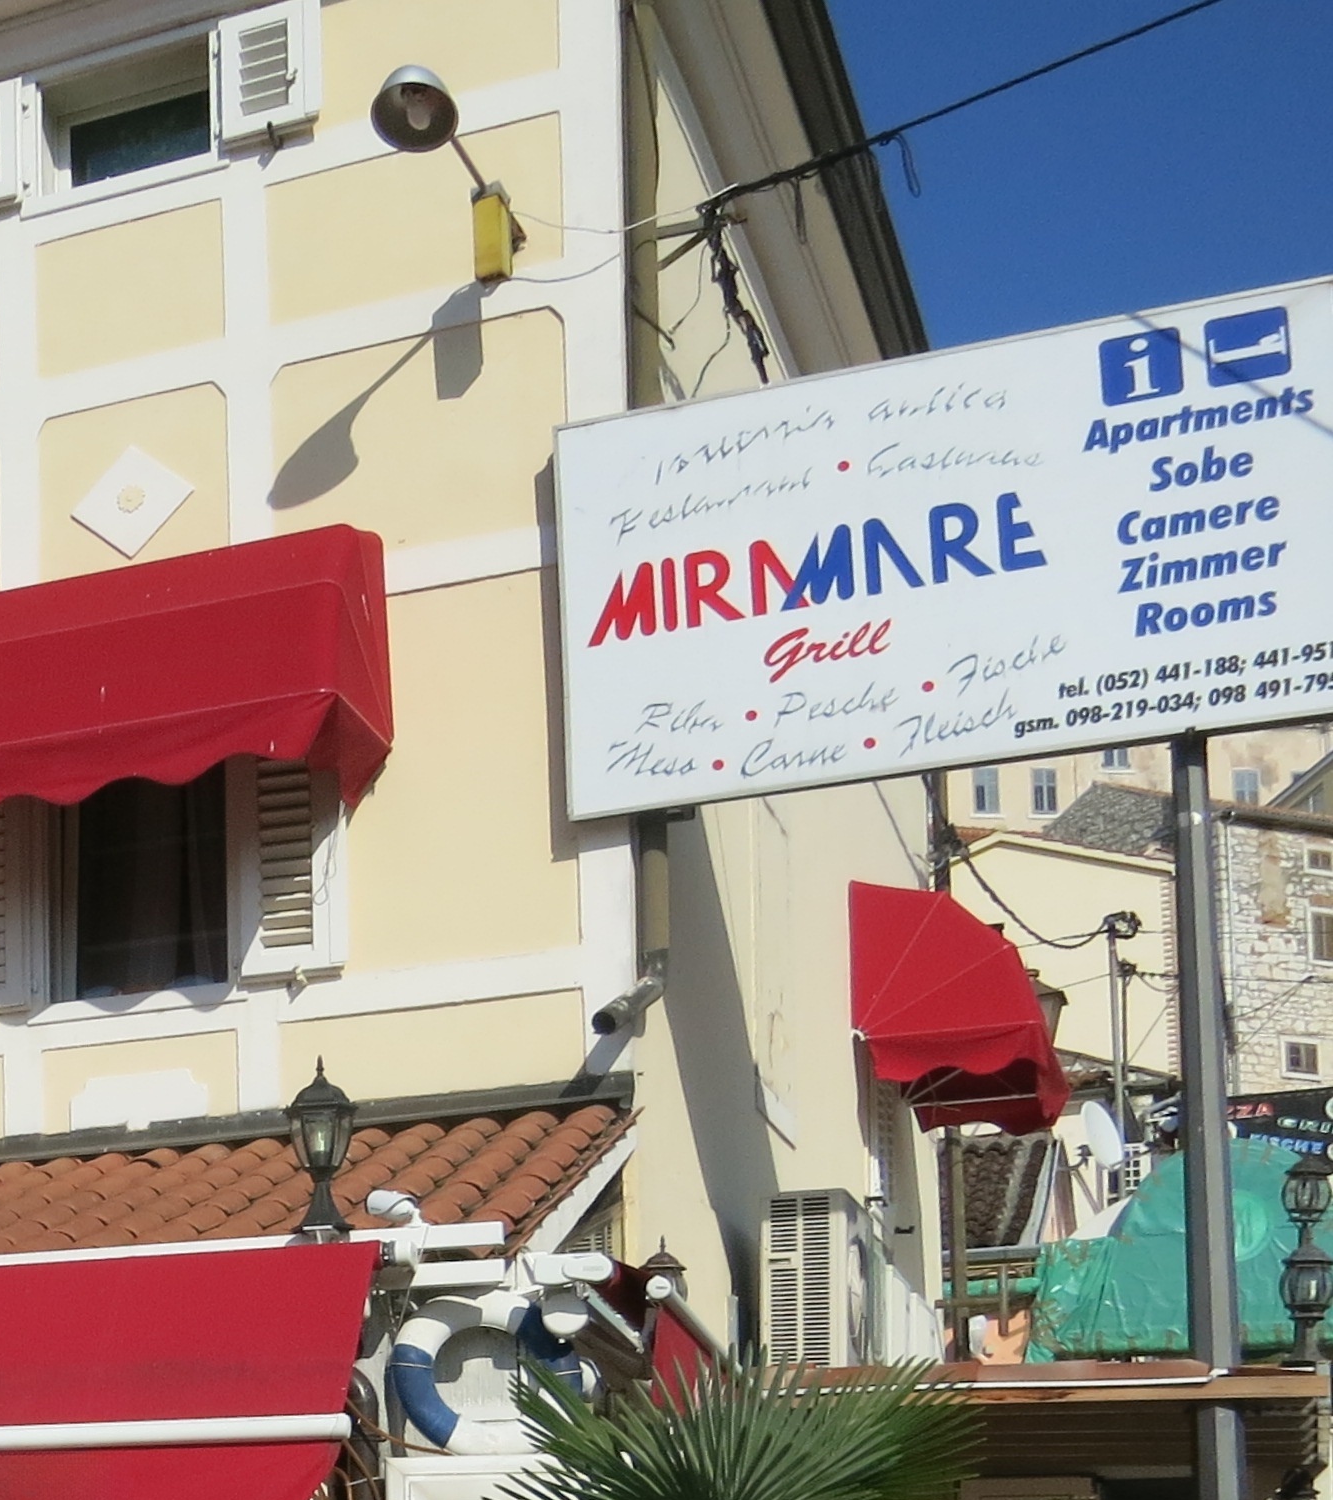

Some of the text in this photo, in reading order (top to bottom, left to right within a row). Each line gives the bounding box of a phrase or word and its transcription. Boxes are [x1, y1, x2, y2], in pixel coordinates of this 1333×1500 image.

[1082, 386, 1314, 454] Apartments
[1149, 446, 1254, 492] Sobe
[1117, 496, 1281, 546] Camere
[588, 492, 1048, 647] MIRAMARE
[1118, 541, 1288, 594] Zimmer
[1135, 591, 1277, 638] Rooms
[764, 618, 893, 683] Grill
[1058, 676, 1090, 699] tel.
[1096, 668, 1149, 696] (052)
[1155, 654, 1247, 684] 441-188;
[893, 689, 1019, 759] Fleisch
[1014, 716, 1060, 739] gsm.
[1065, 690, 1202, 728] 098-219-034;
[1207, 684, 1247, 707] 098
